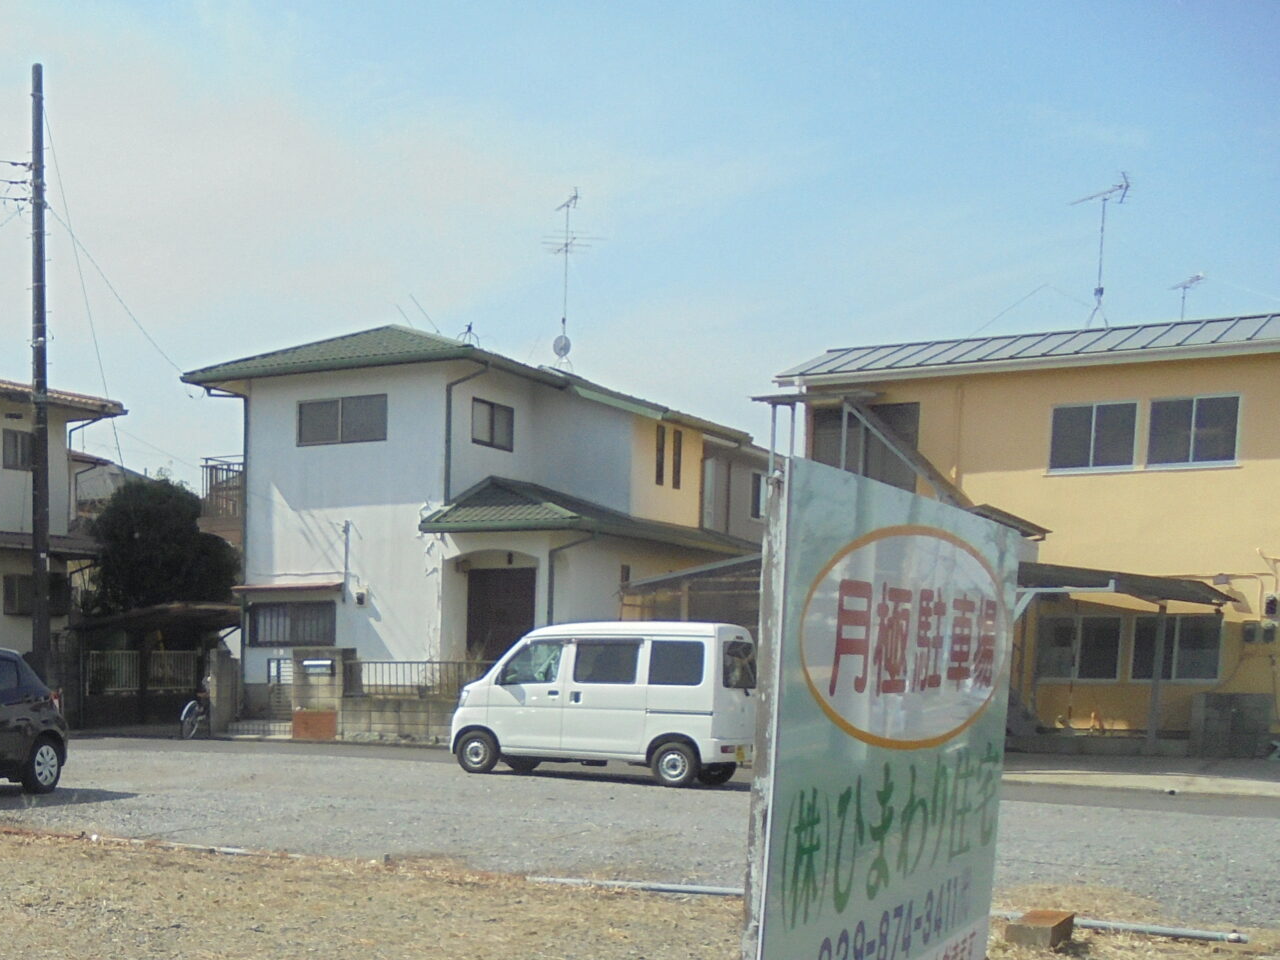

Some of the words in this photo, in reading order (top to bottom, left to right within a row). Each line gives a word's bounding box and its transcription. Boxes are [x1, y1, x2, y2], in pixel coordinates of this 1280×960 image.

[828, 578, 997, 697] 月極駐車場
